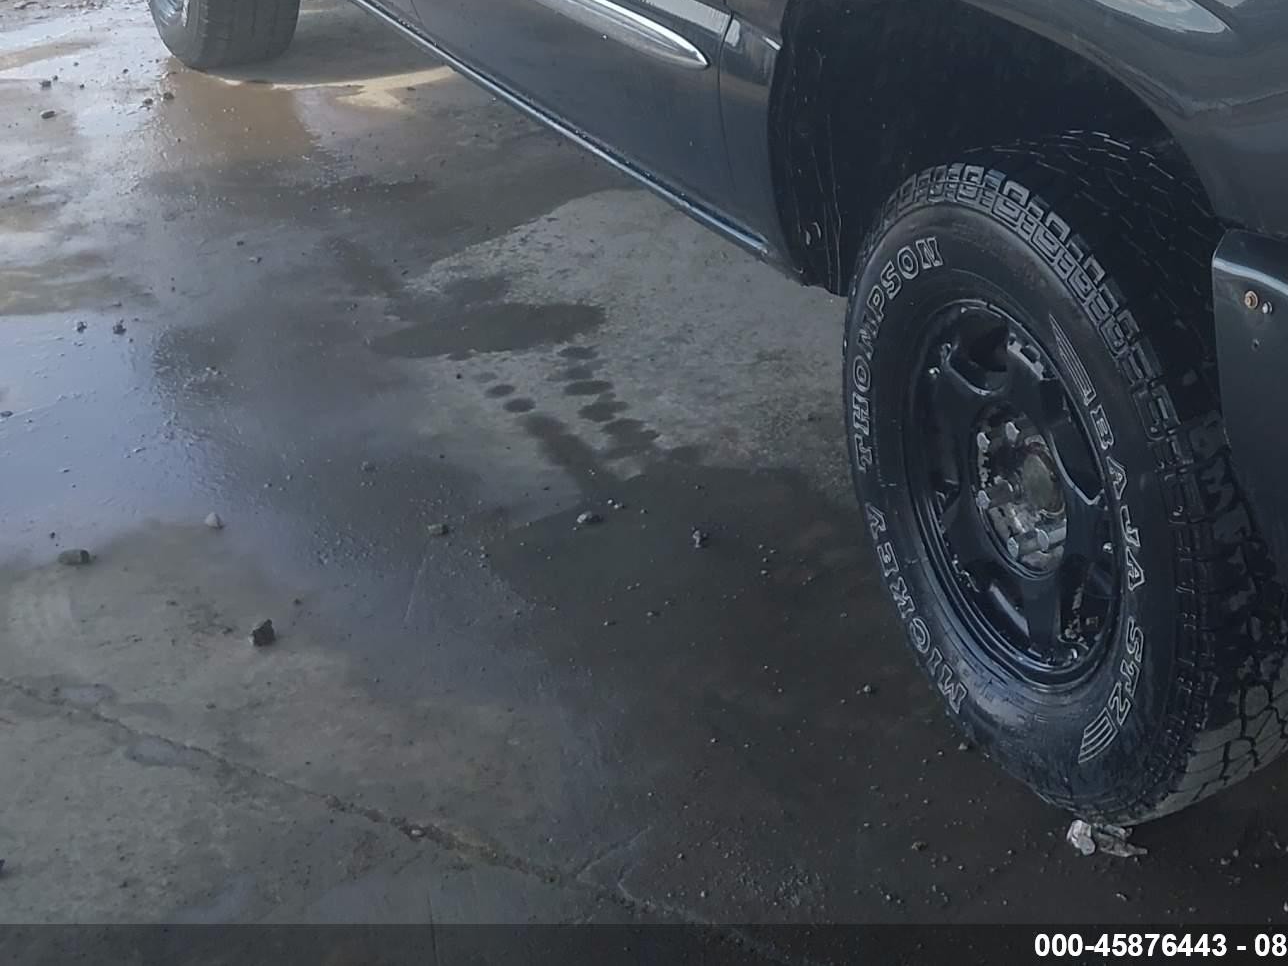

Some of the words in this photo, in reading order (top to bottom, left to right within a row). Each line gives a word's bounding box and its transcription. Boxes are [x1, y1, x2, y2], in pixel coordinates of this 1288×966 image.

[853, 237, 943, 473] THOMPSON
[1090, 404, 1144, 591] BAJA
[865, 502, 968, 714] MICKEY
[1108, 616, 1144, 726] STZ
